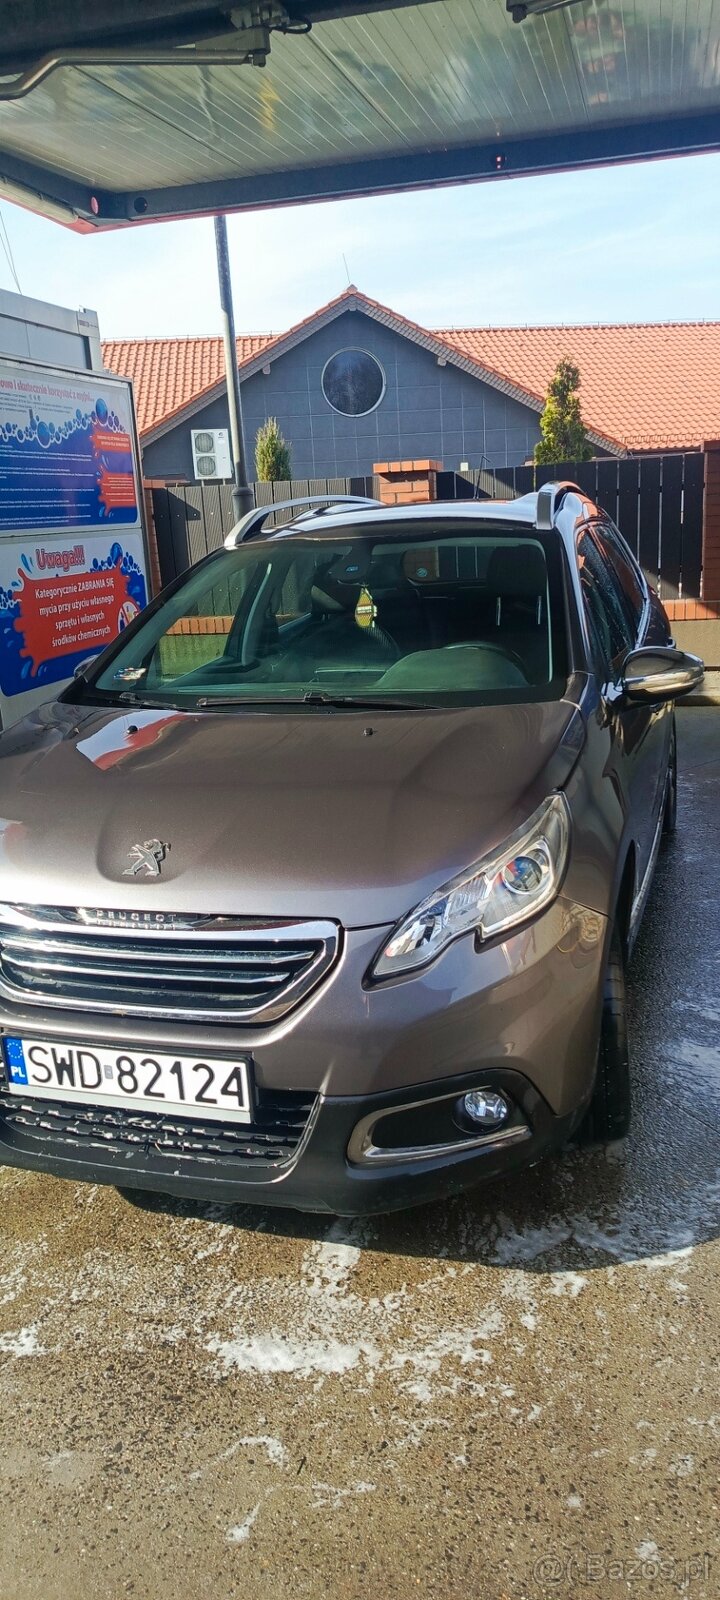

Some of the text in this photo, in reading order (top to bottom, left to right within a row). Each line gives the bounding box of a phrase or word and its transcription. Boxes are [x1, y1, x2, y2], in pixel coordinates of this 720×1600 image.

[35, 545, 86, 572] Uwaga!!!
[35, 577, 114, 599] Kategorycznie ZABRANIA SIĘ
[39, 594, 114, 617] mycia przy użyciu własnego
[55, 618, 77, 631] sprzętu
[81, 611, 105, 624] własnych
[52, 625, 111, 647] środków chemicznych
[96, 909, 176, 922] PEUGEOT
[11, 1066, 25, 1079] PL
[28, 1045, 245, 1107] SWD 82124
